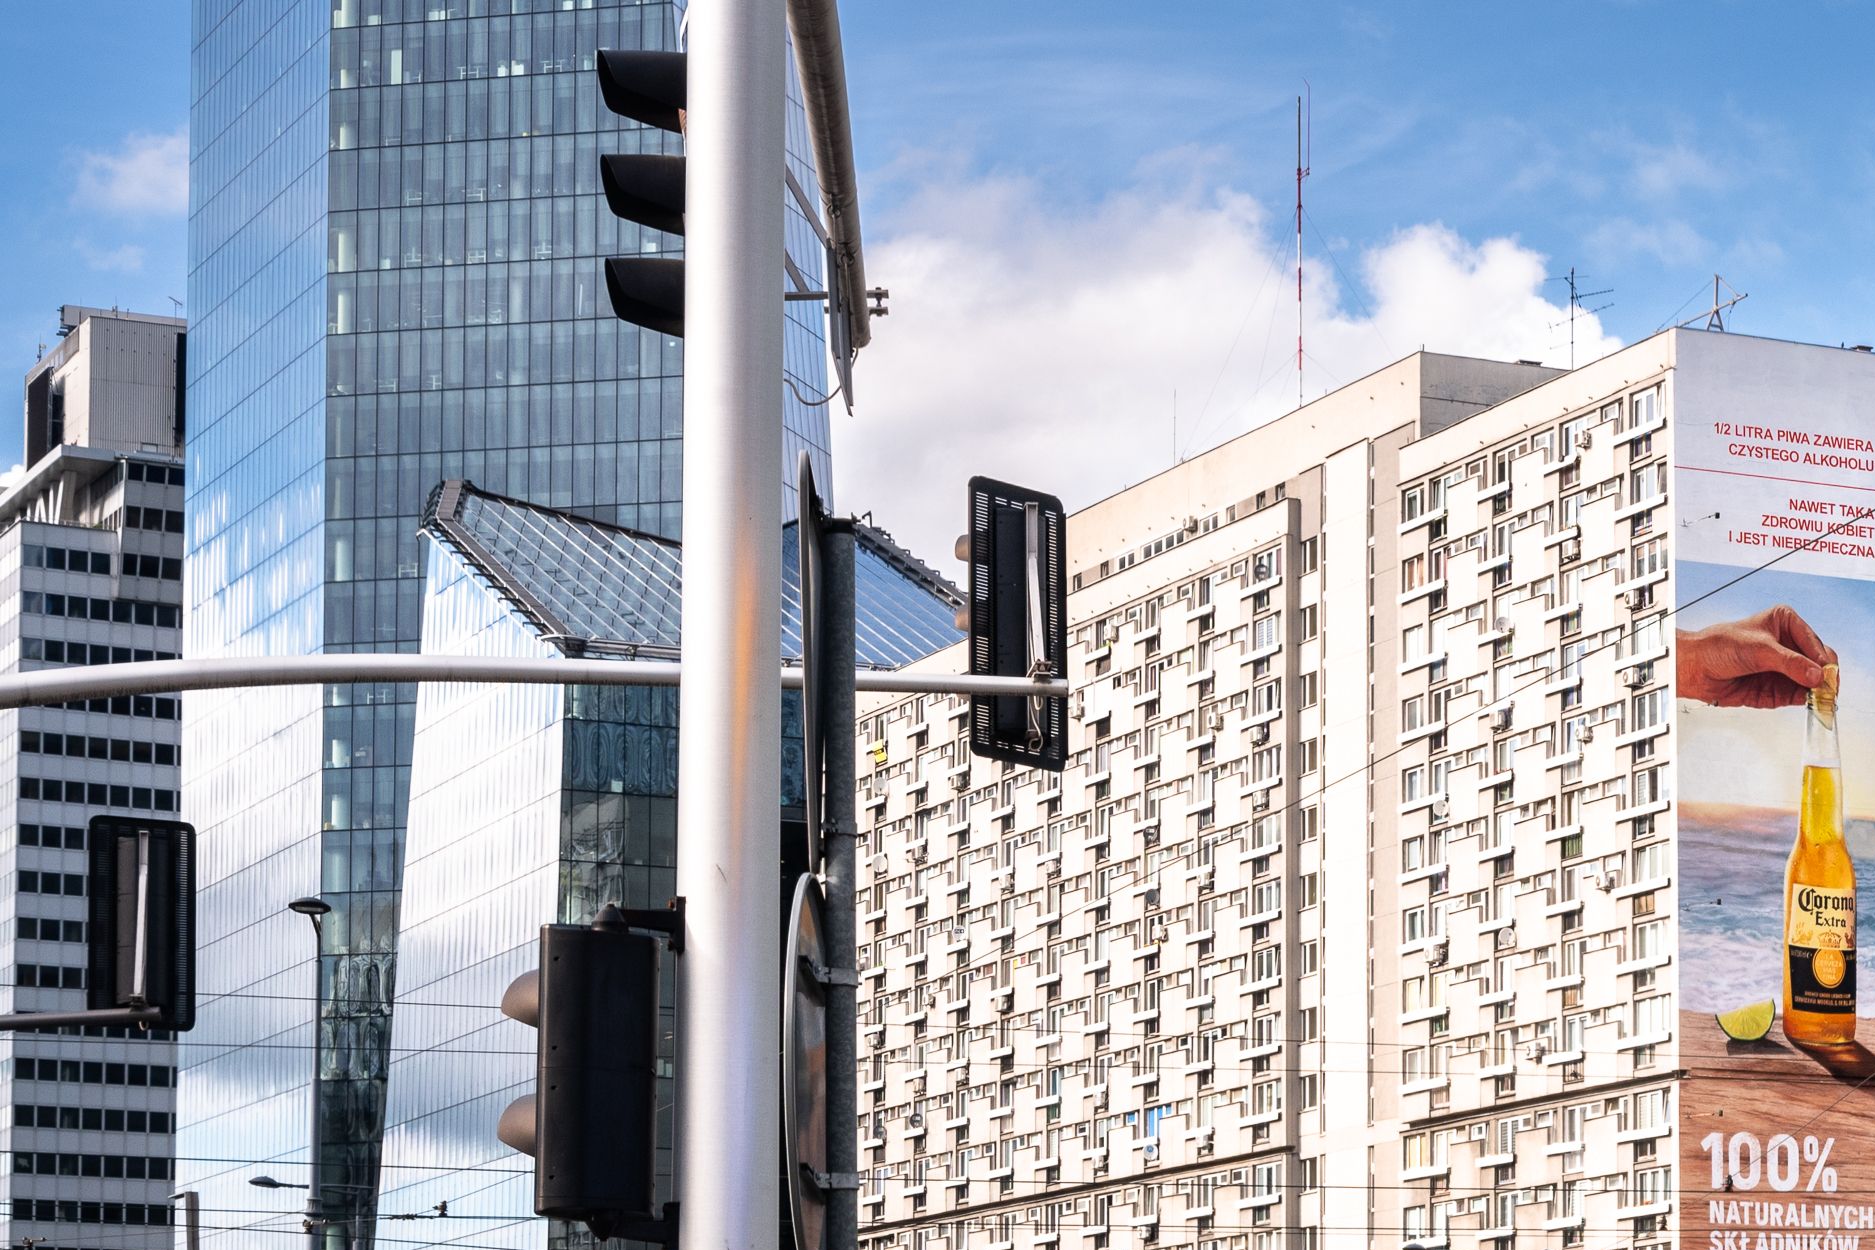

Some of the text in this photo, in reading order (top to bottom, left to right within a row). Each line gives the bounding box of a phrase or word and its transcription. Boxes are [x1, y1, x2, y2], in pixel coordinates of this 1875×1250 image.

[1714, 422, 1731, 435] 1/2
[1735, 424, 1773, 440] LITRA
[1778, 430, 1810, 445] PIWA
[1814, 434, 1874, 452] ZAWIERA
[1728, 443, 1800, 462] CZYSTEGO
[1803, 452, 1874, 472] ALKOHOLU
[1789, 498, 1836, 515] NAWET
[1839, 504, 1875, 520] TAKA
[1762, 514, 1823, 533] ZDROWIU
[1827, 522, 1875, 539] KOBIET
[1728, 530, 1732, 542] I
[1736, 532, 1768, 546] JEST
[1772, 536, 1875, 559] NIEBEZPIECZNA
[1798, 887, 1855, 915] Corona
[1815, 911, 1847, 928] Extra
[1700, 1131, 1838, 1193] 100%
[1709, 1200, 1874, 1230] NATURALNYCH
